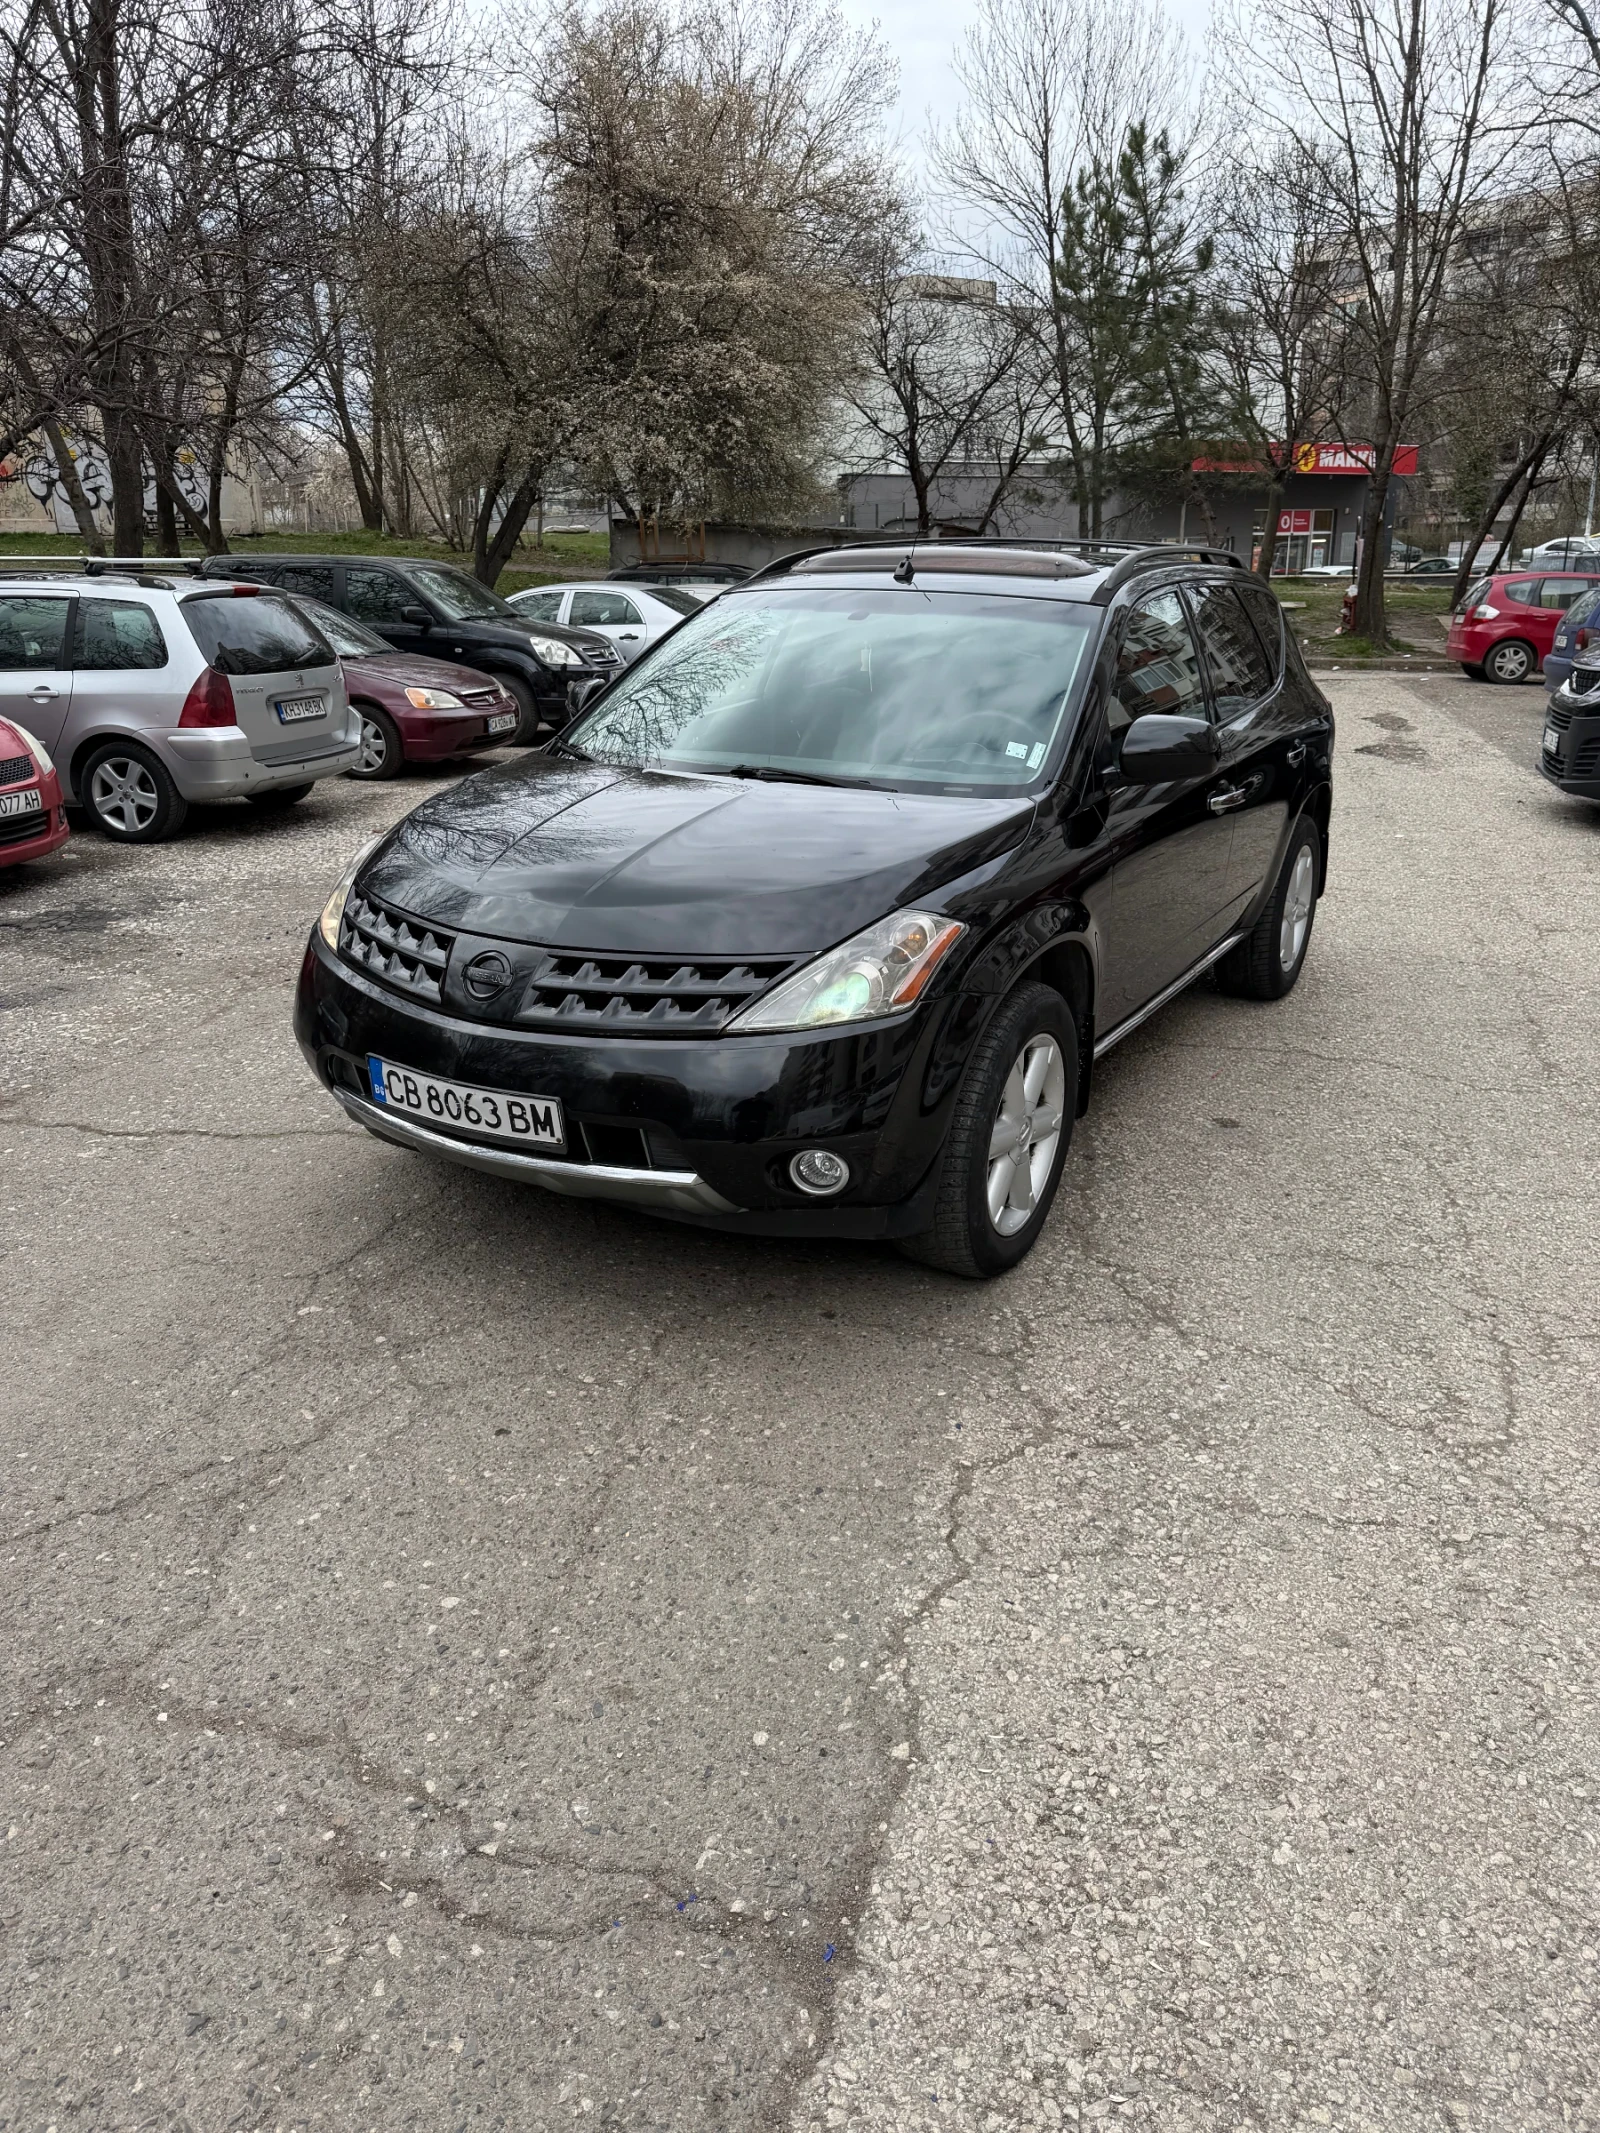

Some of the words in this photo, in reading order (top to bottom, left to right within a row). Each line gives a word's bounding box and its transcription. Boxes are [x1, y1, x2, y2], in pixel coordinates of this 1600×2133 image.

[24, 791, 40, 810] AH
[374, 1083, 385, 1096] BG
[387, 1069, 422, 1109] CB
[426, 1083, 501, 1129] 8063
[507, 1100, 555, 1138] BM
